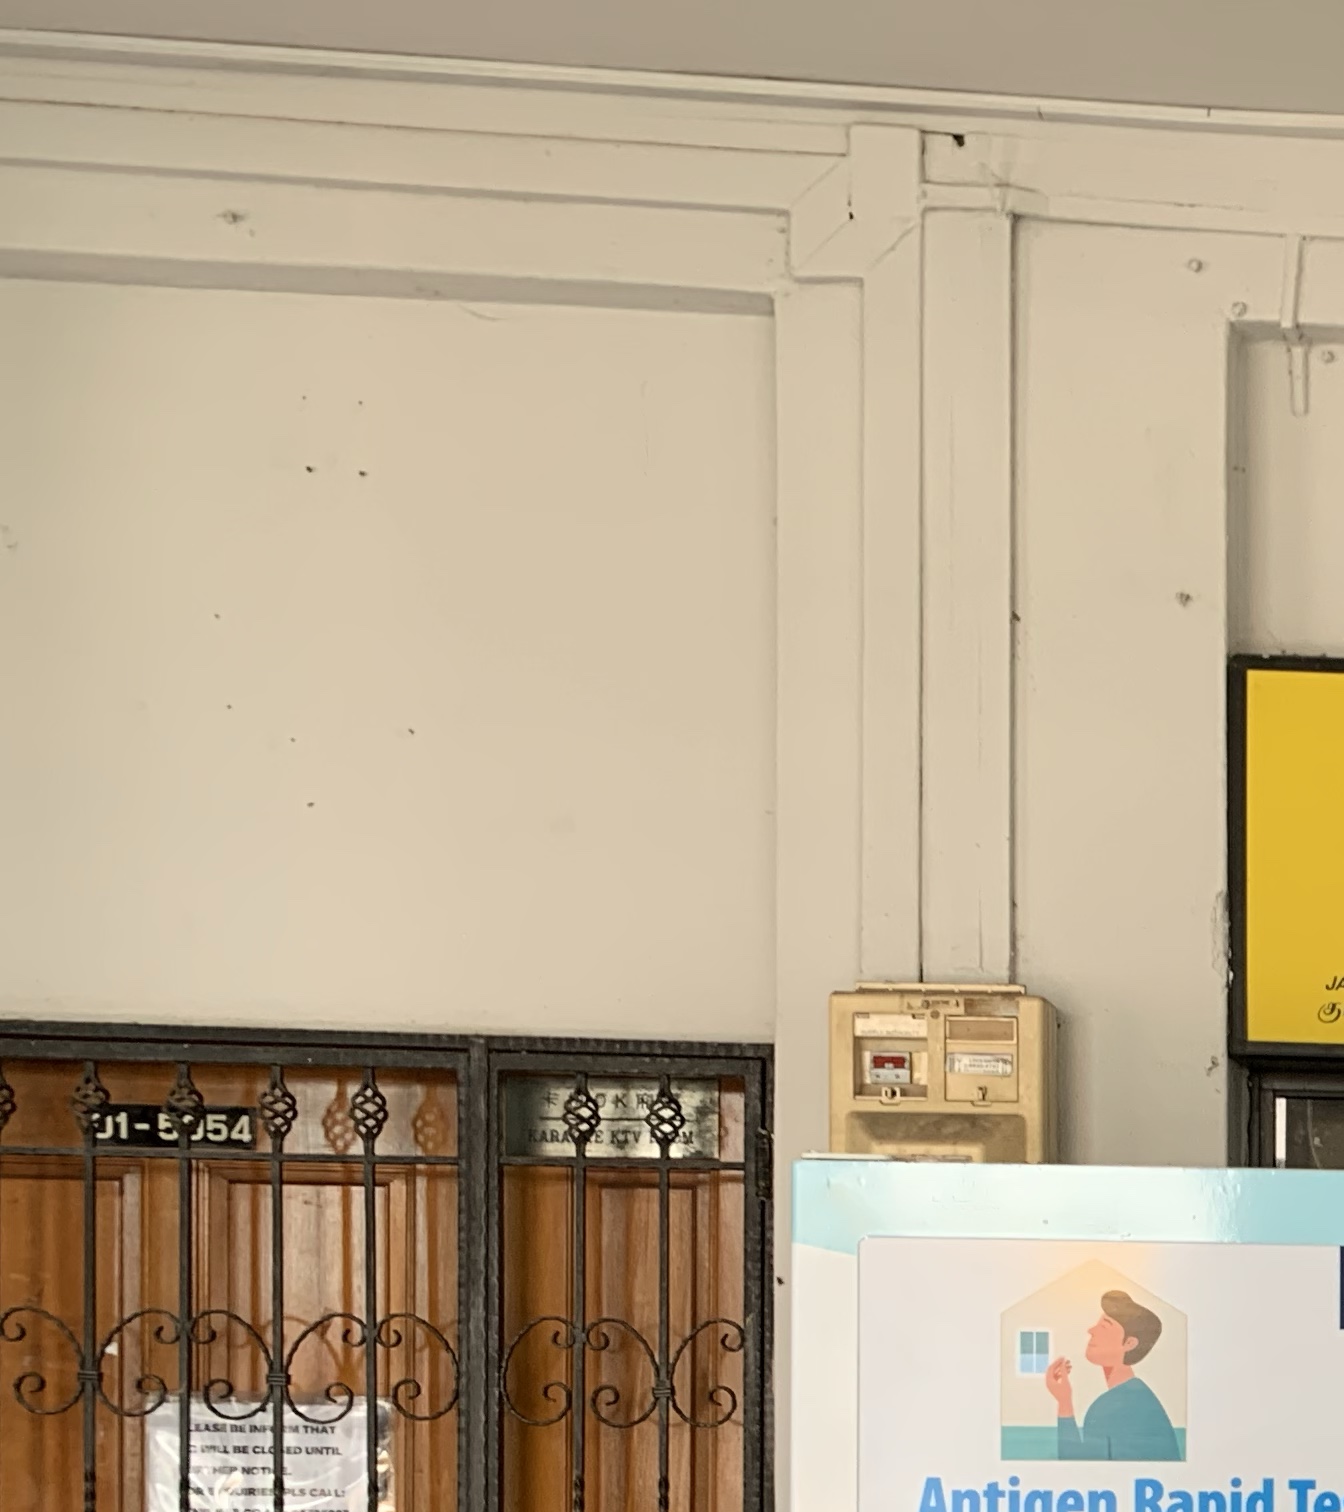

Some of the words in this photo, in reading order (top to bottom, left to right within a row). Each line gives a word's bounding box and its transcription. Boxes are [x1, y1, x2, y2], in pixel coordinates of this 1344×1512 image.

[303, 1426, 336, 1435] THAT
[233, 1446, 249, 1454] BE
[306, 1447, 343, 1456] UNTIL
